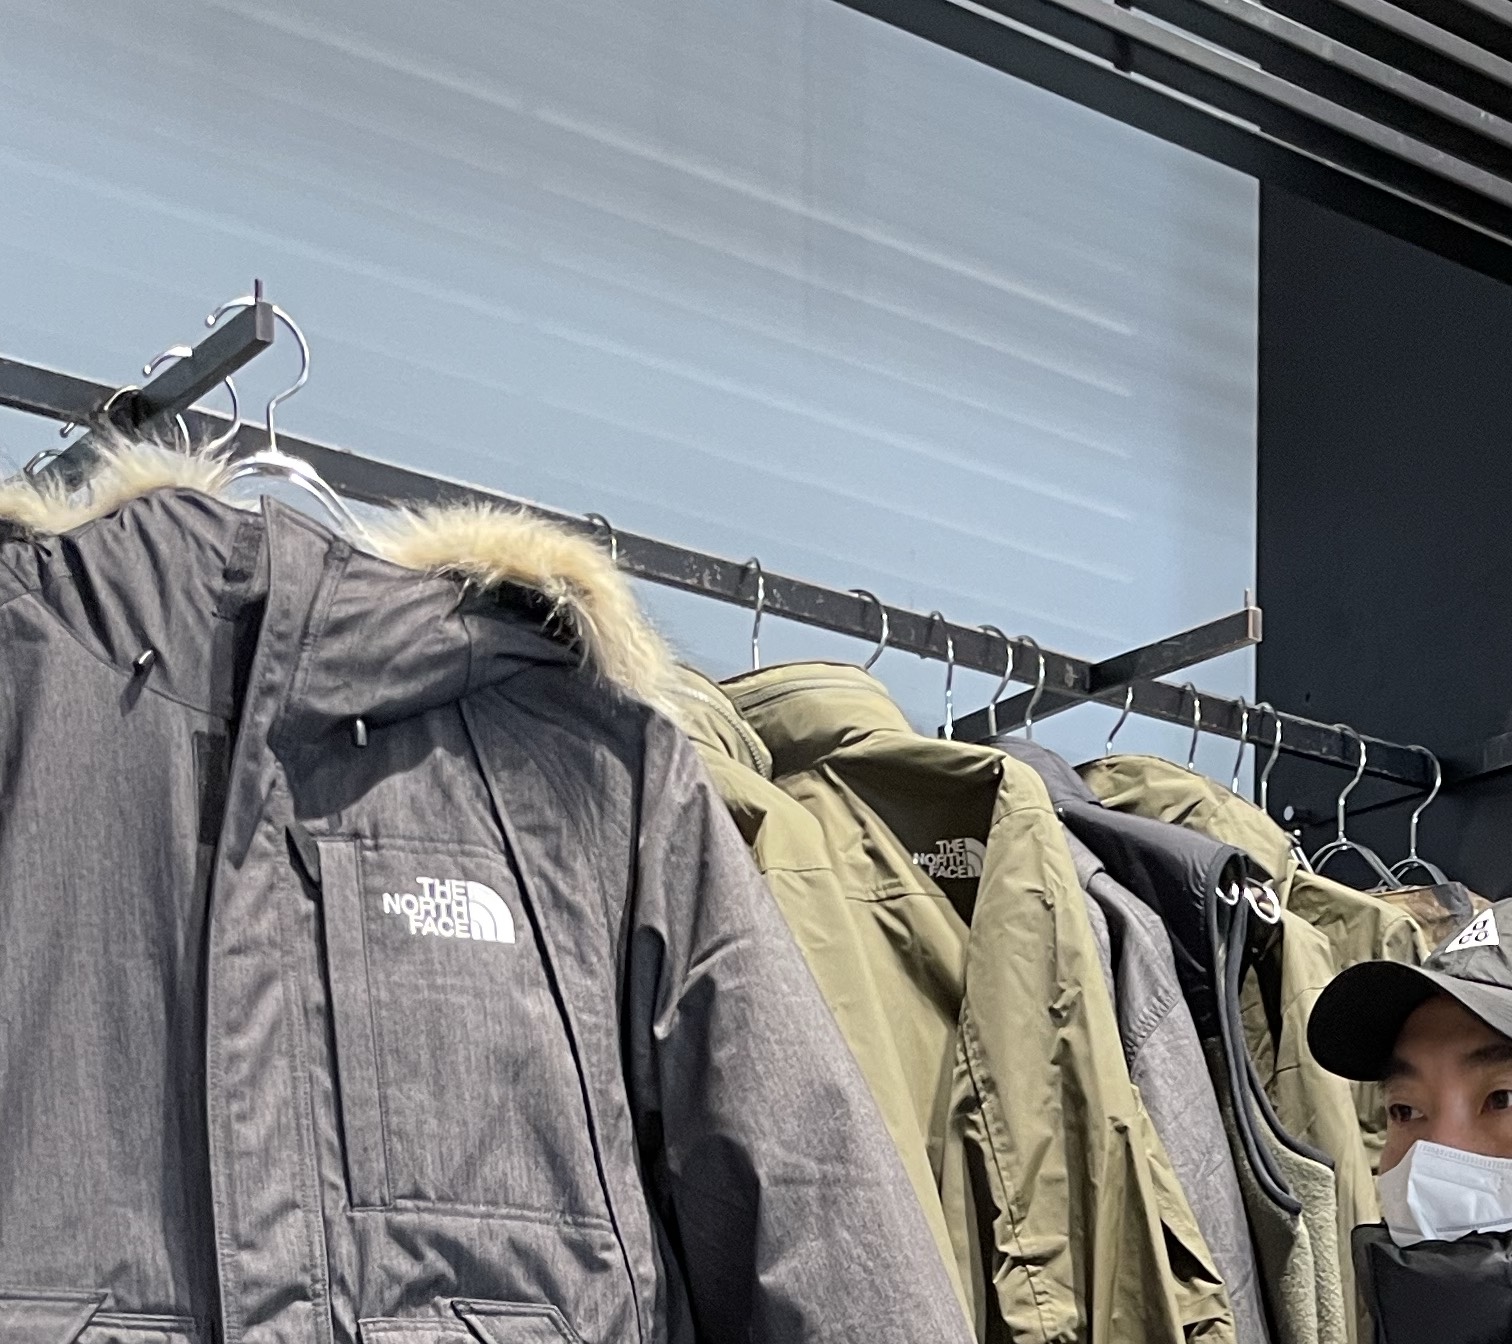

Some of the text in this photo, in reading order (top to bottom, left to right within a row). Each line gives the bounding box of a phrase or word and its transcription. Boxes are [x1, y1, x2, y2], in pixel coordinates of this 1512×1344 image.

[935, 838, 966, 854] THE
[415, 876, 468, 900] THE
[382, 892, 470, 920] NORTH
[409, 915, 471, 939] FACE
